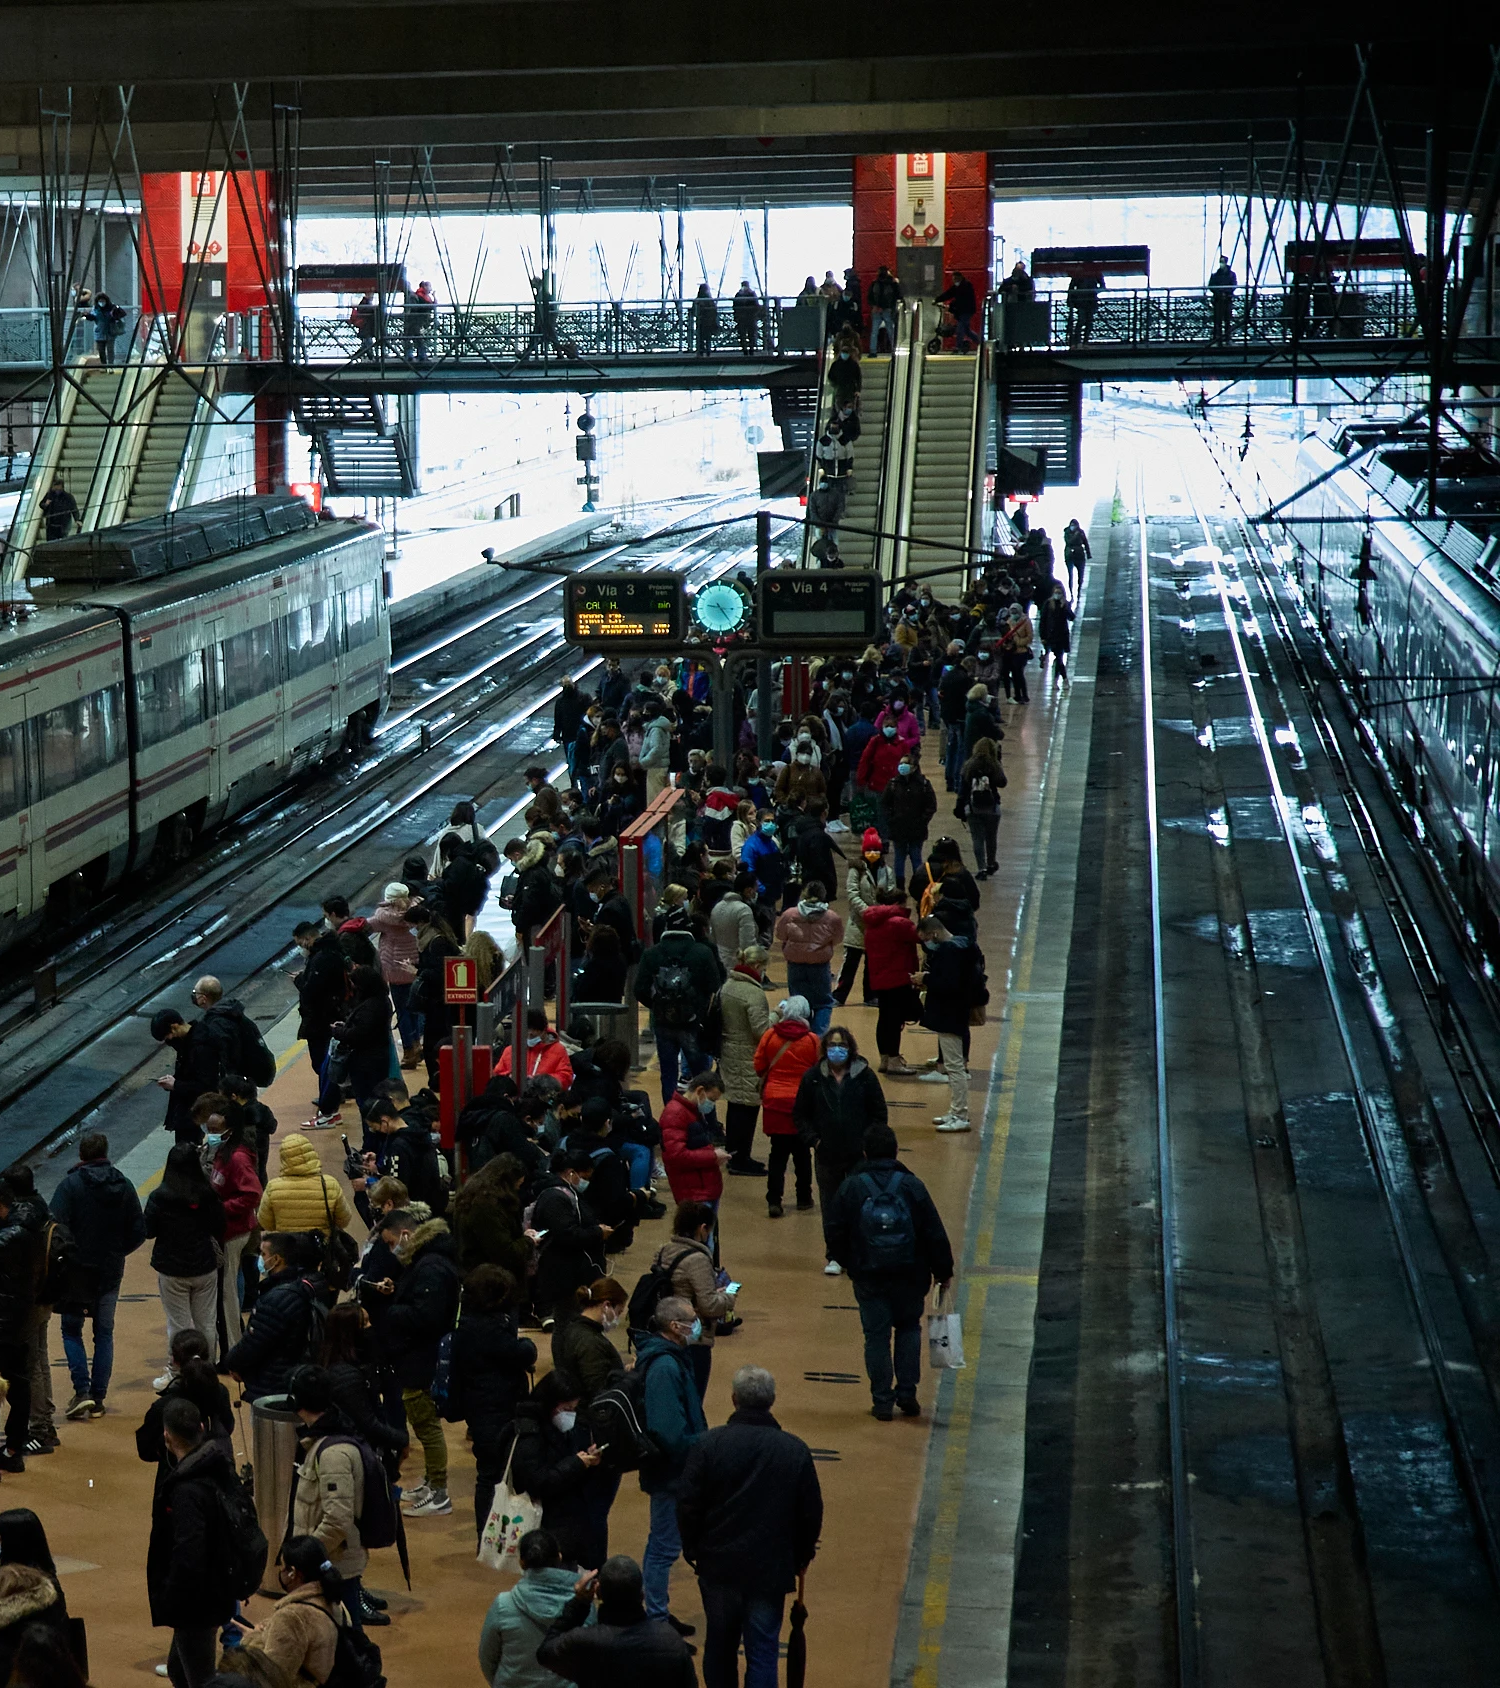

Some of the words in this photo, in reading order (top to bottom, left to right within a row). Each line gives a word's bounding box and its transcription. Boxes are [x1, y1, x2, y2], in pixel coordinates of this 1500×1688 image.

[597, 584, 617, 596] Vía
[627, 584, 635, 596] 3
[792, 581, 812, 594] Vía
[819, 581, 828, 593] 4
